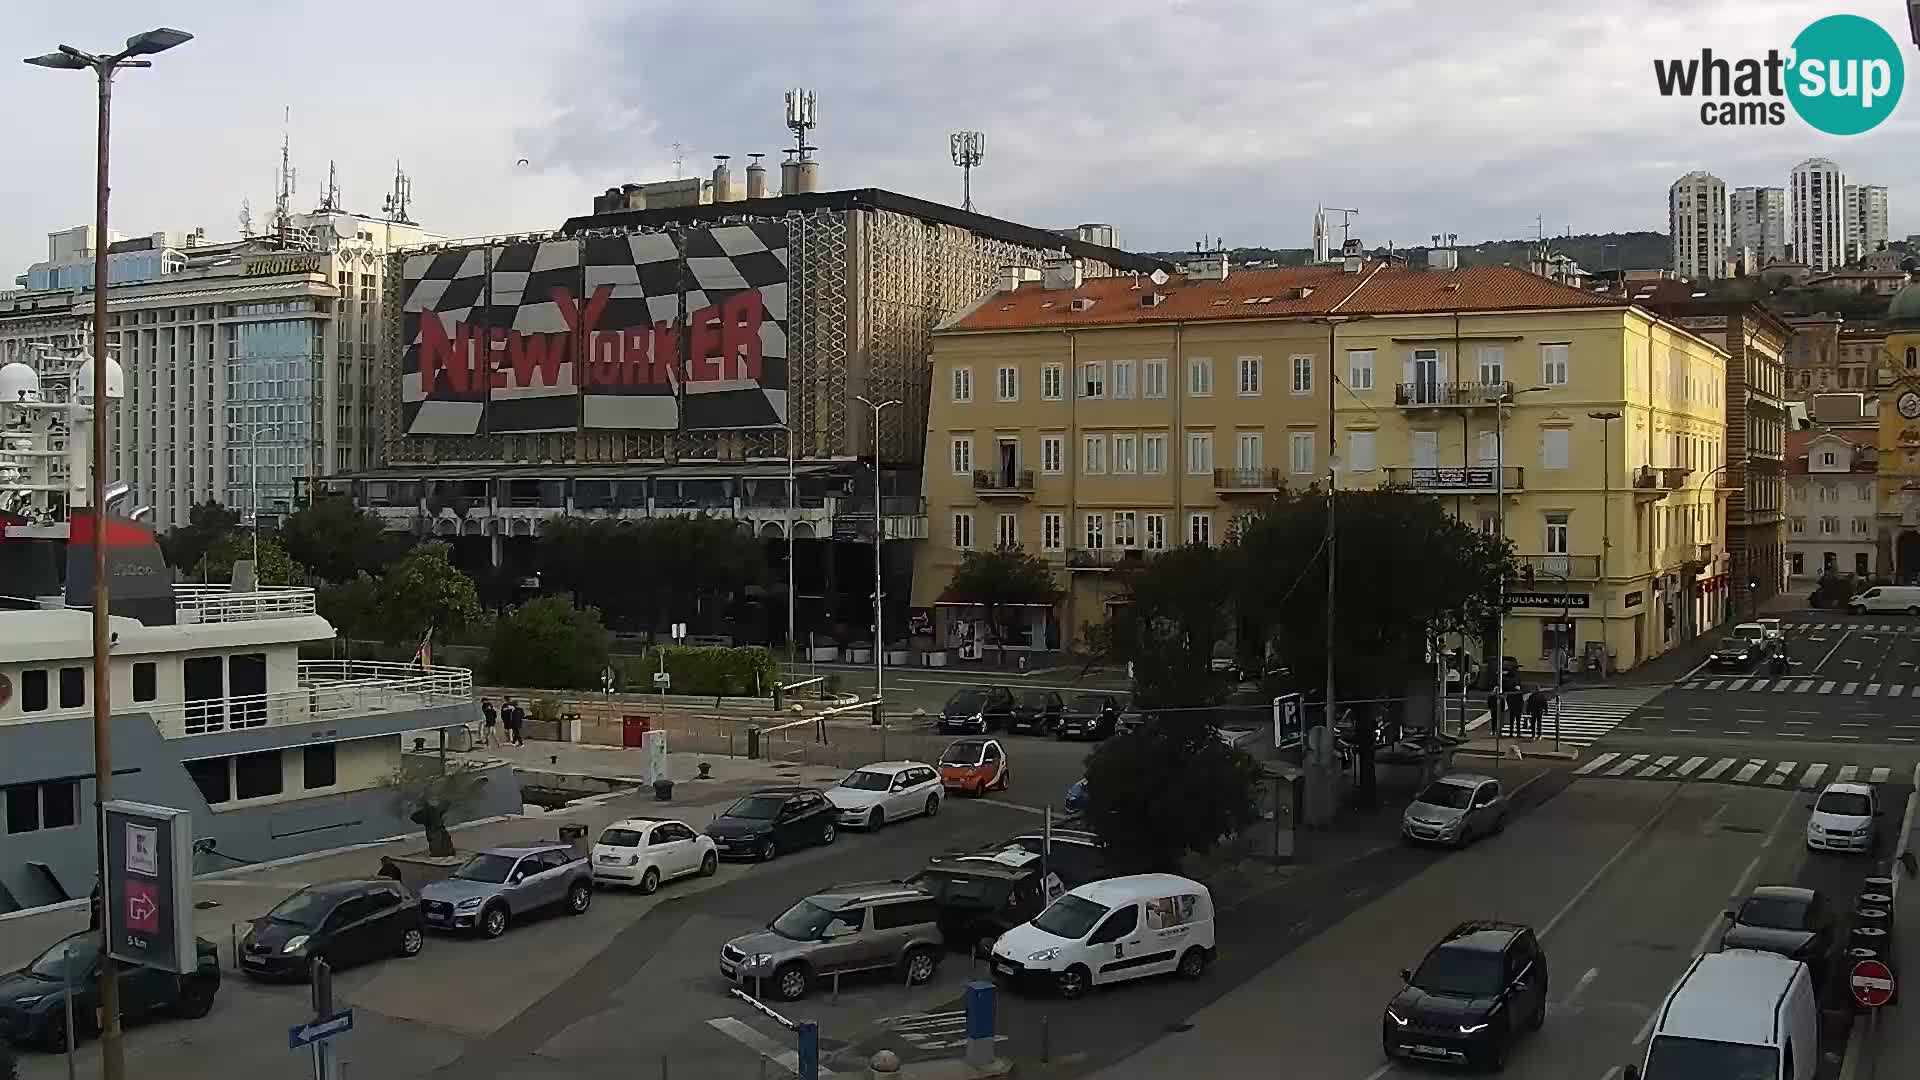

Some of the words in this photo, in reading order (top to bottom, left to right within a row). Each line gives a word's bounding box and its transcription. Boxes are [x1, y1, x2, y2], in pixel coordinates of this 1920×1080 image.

[549, 286, 764, 386] YORKER
[1505, 595, 1550, 605] JULIANA
[1553, 596, 1585, 606] NAILS
